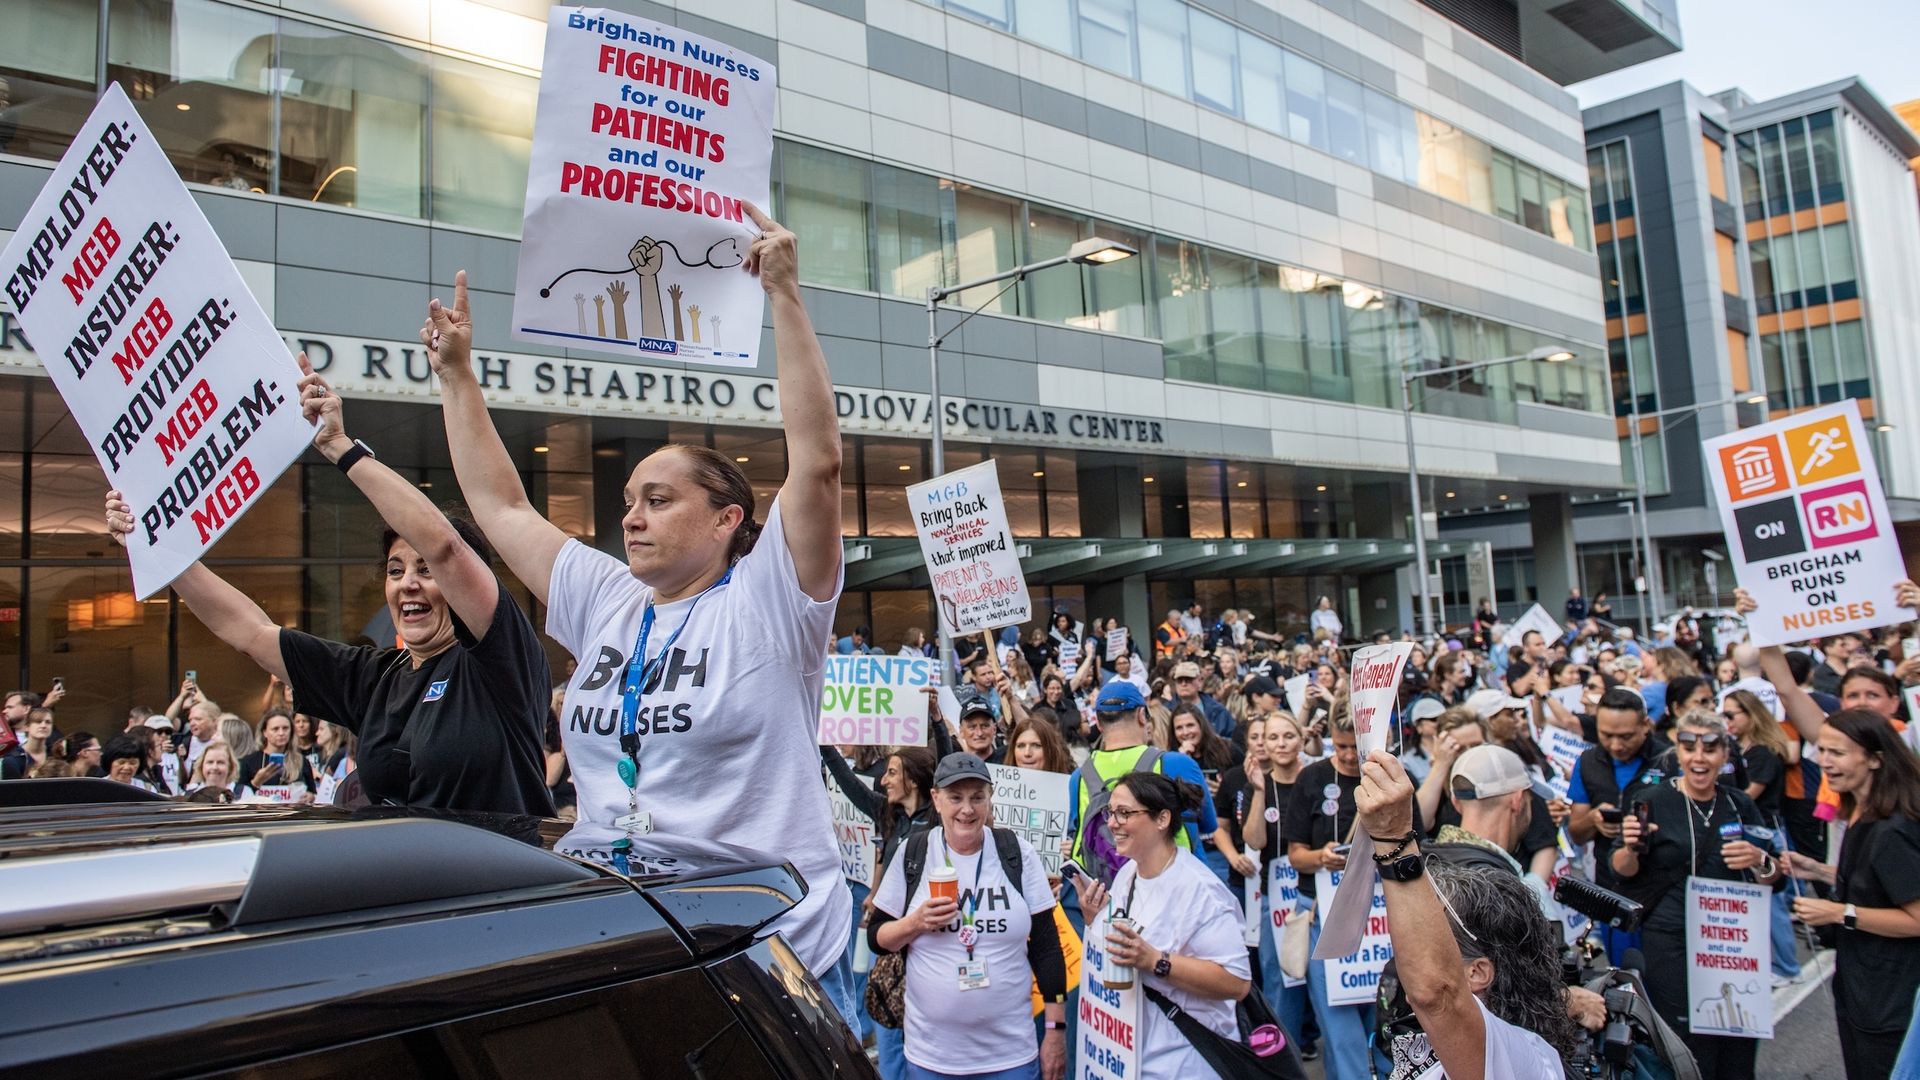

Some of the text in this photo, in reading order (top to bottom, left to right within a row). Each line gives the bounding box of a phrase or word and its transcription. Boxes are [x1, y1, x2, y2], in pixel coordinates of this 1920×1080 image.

[568, 13, 760, 82] Brigham Nurses
[598, 44, 729, 106] FIGHTING
[621, 84, 705, 122] for our
[591, 102, 725, 163] PATIENTS
[608, 147, 705, 182] and our
[560, 161, 743, 223] PROFESSION
[5, 120, 137, 314] EMPLOYER:
[61, 216, 121, 306] MGB
[64, 220, 181, 380] INSURER:
[111, 297, 174, 386] MGB
[640, 339, 674, 352] MNA
[101, 297, 237, 473] PROVIDER:
[362, 345, 511, 389] RUH
[535, 362, 735, 407] SHAPIRO
[753, 383, 1058, 436] CDIOVASCULAR
[1070, 414, 1164, 443] CENTER
[155, 378, 218, 466] MGB
[141, 379, 285, 546] PROBLEM:
[191, 456, 261, 546] MGB
[928, 481, 968, 505] MGB
[921, 494, 988, 528] Bring Back
[1754, 499, 1865, 540] ON RN
[930, 518, 989, 540] NONCLINICAL
[944, 528, 983, 546] SERVICES
[931, 532, 1006, 567] that improved
[1767, 549, 1862, 580] BRIGHAM
[934, 560, 993, 591] PATIENT'S
[953, 575, 1019, 606] WELLBEING
[1791, 571, 1846, 593] RUNS
[972, 602, 989, 612] miss
[1807, 590, 1837, 607] ON
[1782, 601, 1876, 631] NURSES
[827, 657, 929, 686] ATIENTS
[570, 703, 692, 735] NUSES
[821, 716, 920, 744] ROFITS
[996, 768, 1021, 781] MGB
[957, 886, 1011, 911] WH
[1699, 897, 1749, 914] FIGHTING
[1726, 886, 1763, 898] Nurses
[1701, 925, 1749, 943] PATIENTS
[1707, 914, 1739, 925] for our
[1373, 944, 1393, 962] Fai
[1696, 953, 1759, 972] PROFESSION
[1707, 943, 1742, 954] and our
[1080, 997, 1133, 1051] ON STRIKE
[1084, 1033, 1096, 1060] for
[1098, 1048, 1104, 1066] a
[1105, 1049, 1126, 1079] Fair
